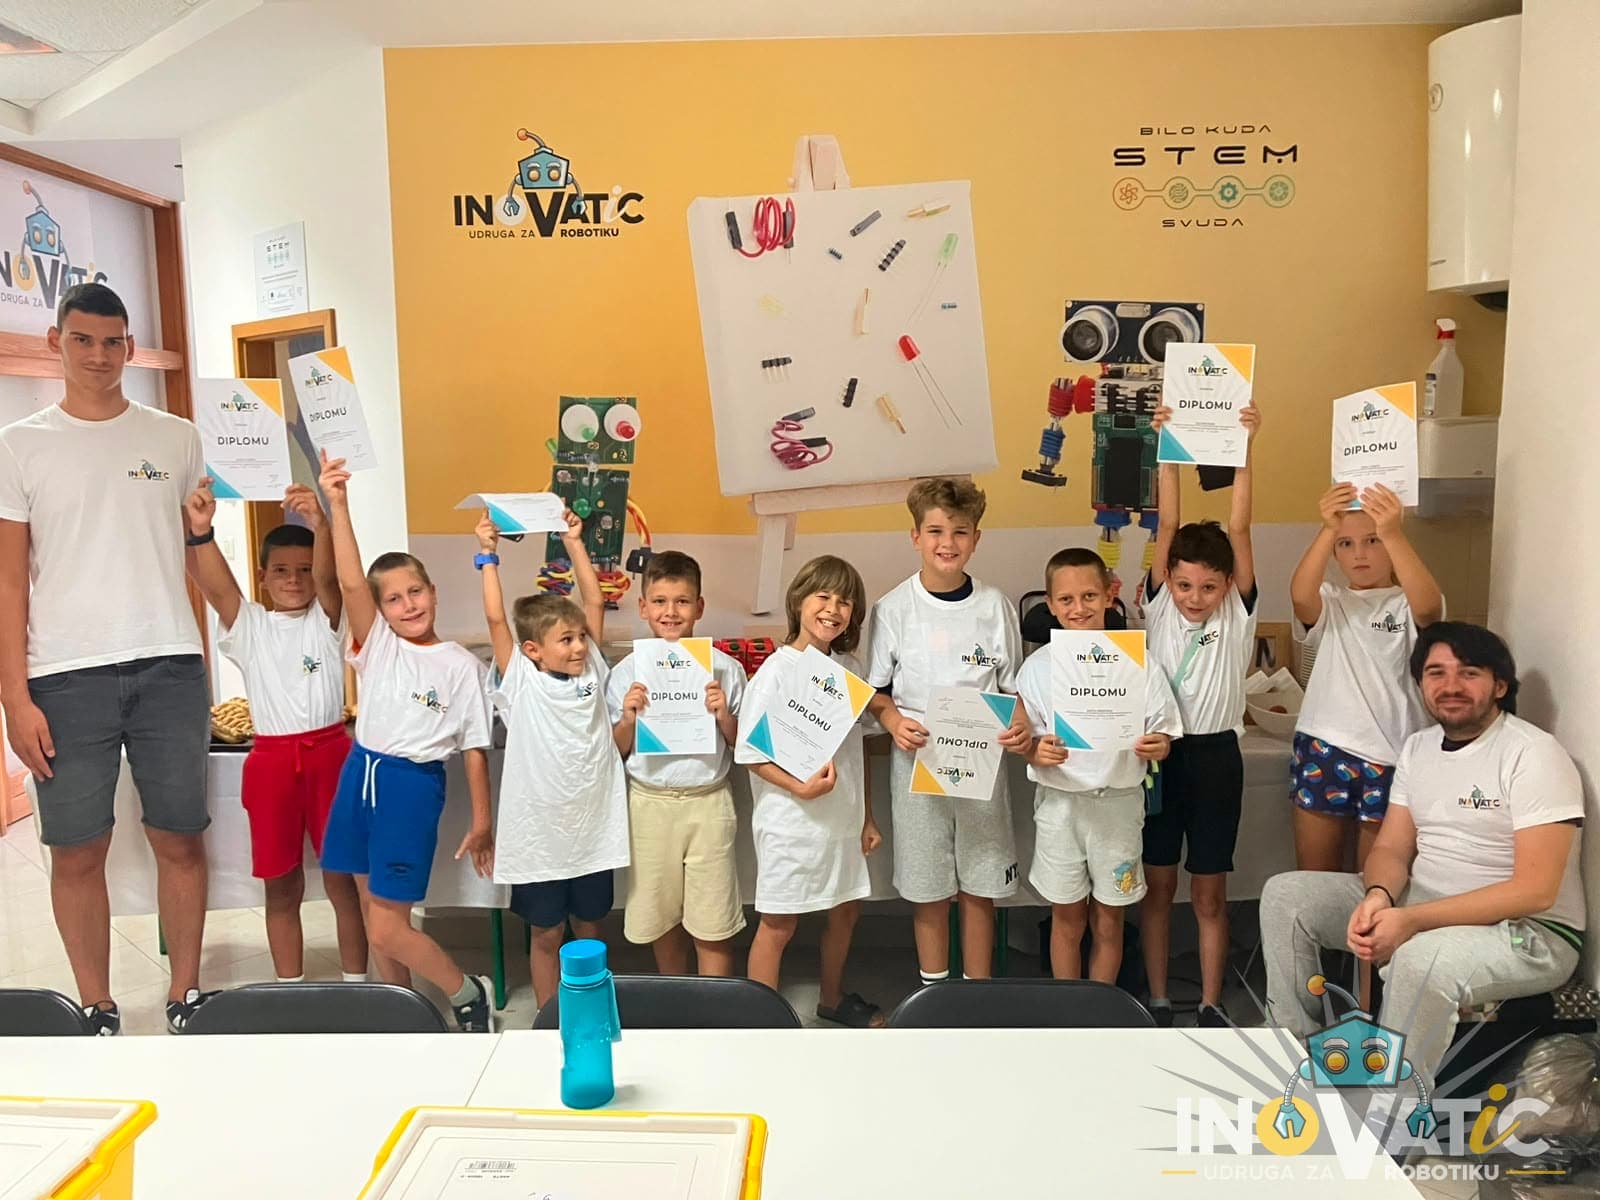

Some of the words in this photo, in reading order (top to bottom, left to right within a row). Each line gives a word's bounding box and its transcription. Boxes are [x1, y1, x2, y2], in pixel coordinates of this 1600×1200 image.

[1140, 126, 1195, 136] BILO
[1205, 125, 1272, 135] KUDA
[1113, 144, 1298, 166] STEM
[1161, 218, 1244, 228] SVUDA
[468, 230, 515, 239] UDRUGA
[521, 230, 535, 239] ZA
[560, 228, 619, 238] ROBOTIKU
[1179, 400, 1232, 410] DIPLOMU
[309, 407, 347, 422] DIPLOMU
[217, 436, 269, 445] DIPLOMU
[1344, 442, 1397, 456] DIPLOMU
[651, 692, 698, 701] DIPLOMU
[1070, 688, 1127, 697] DIPLOMU
[788, 699, 832, 731] DIPLOMU
[937, 736, 988, 749] DIPLOMU
